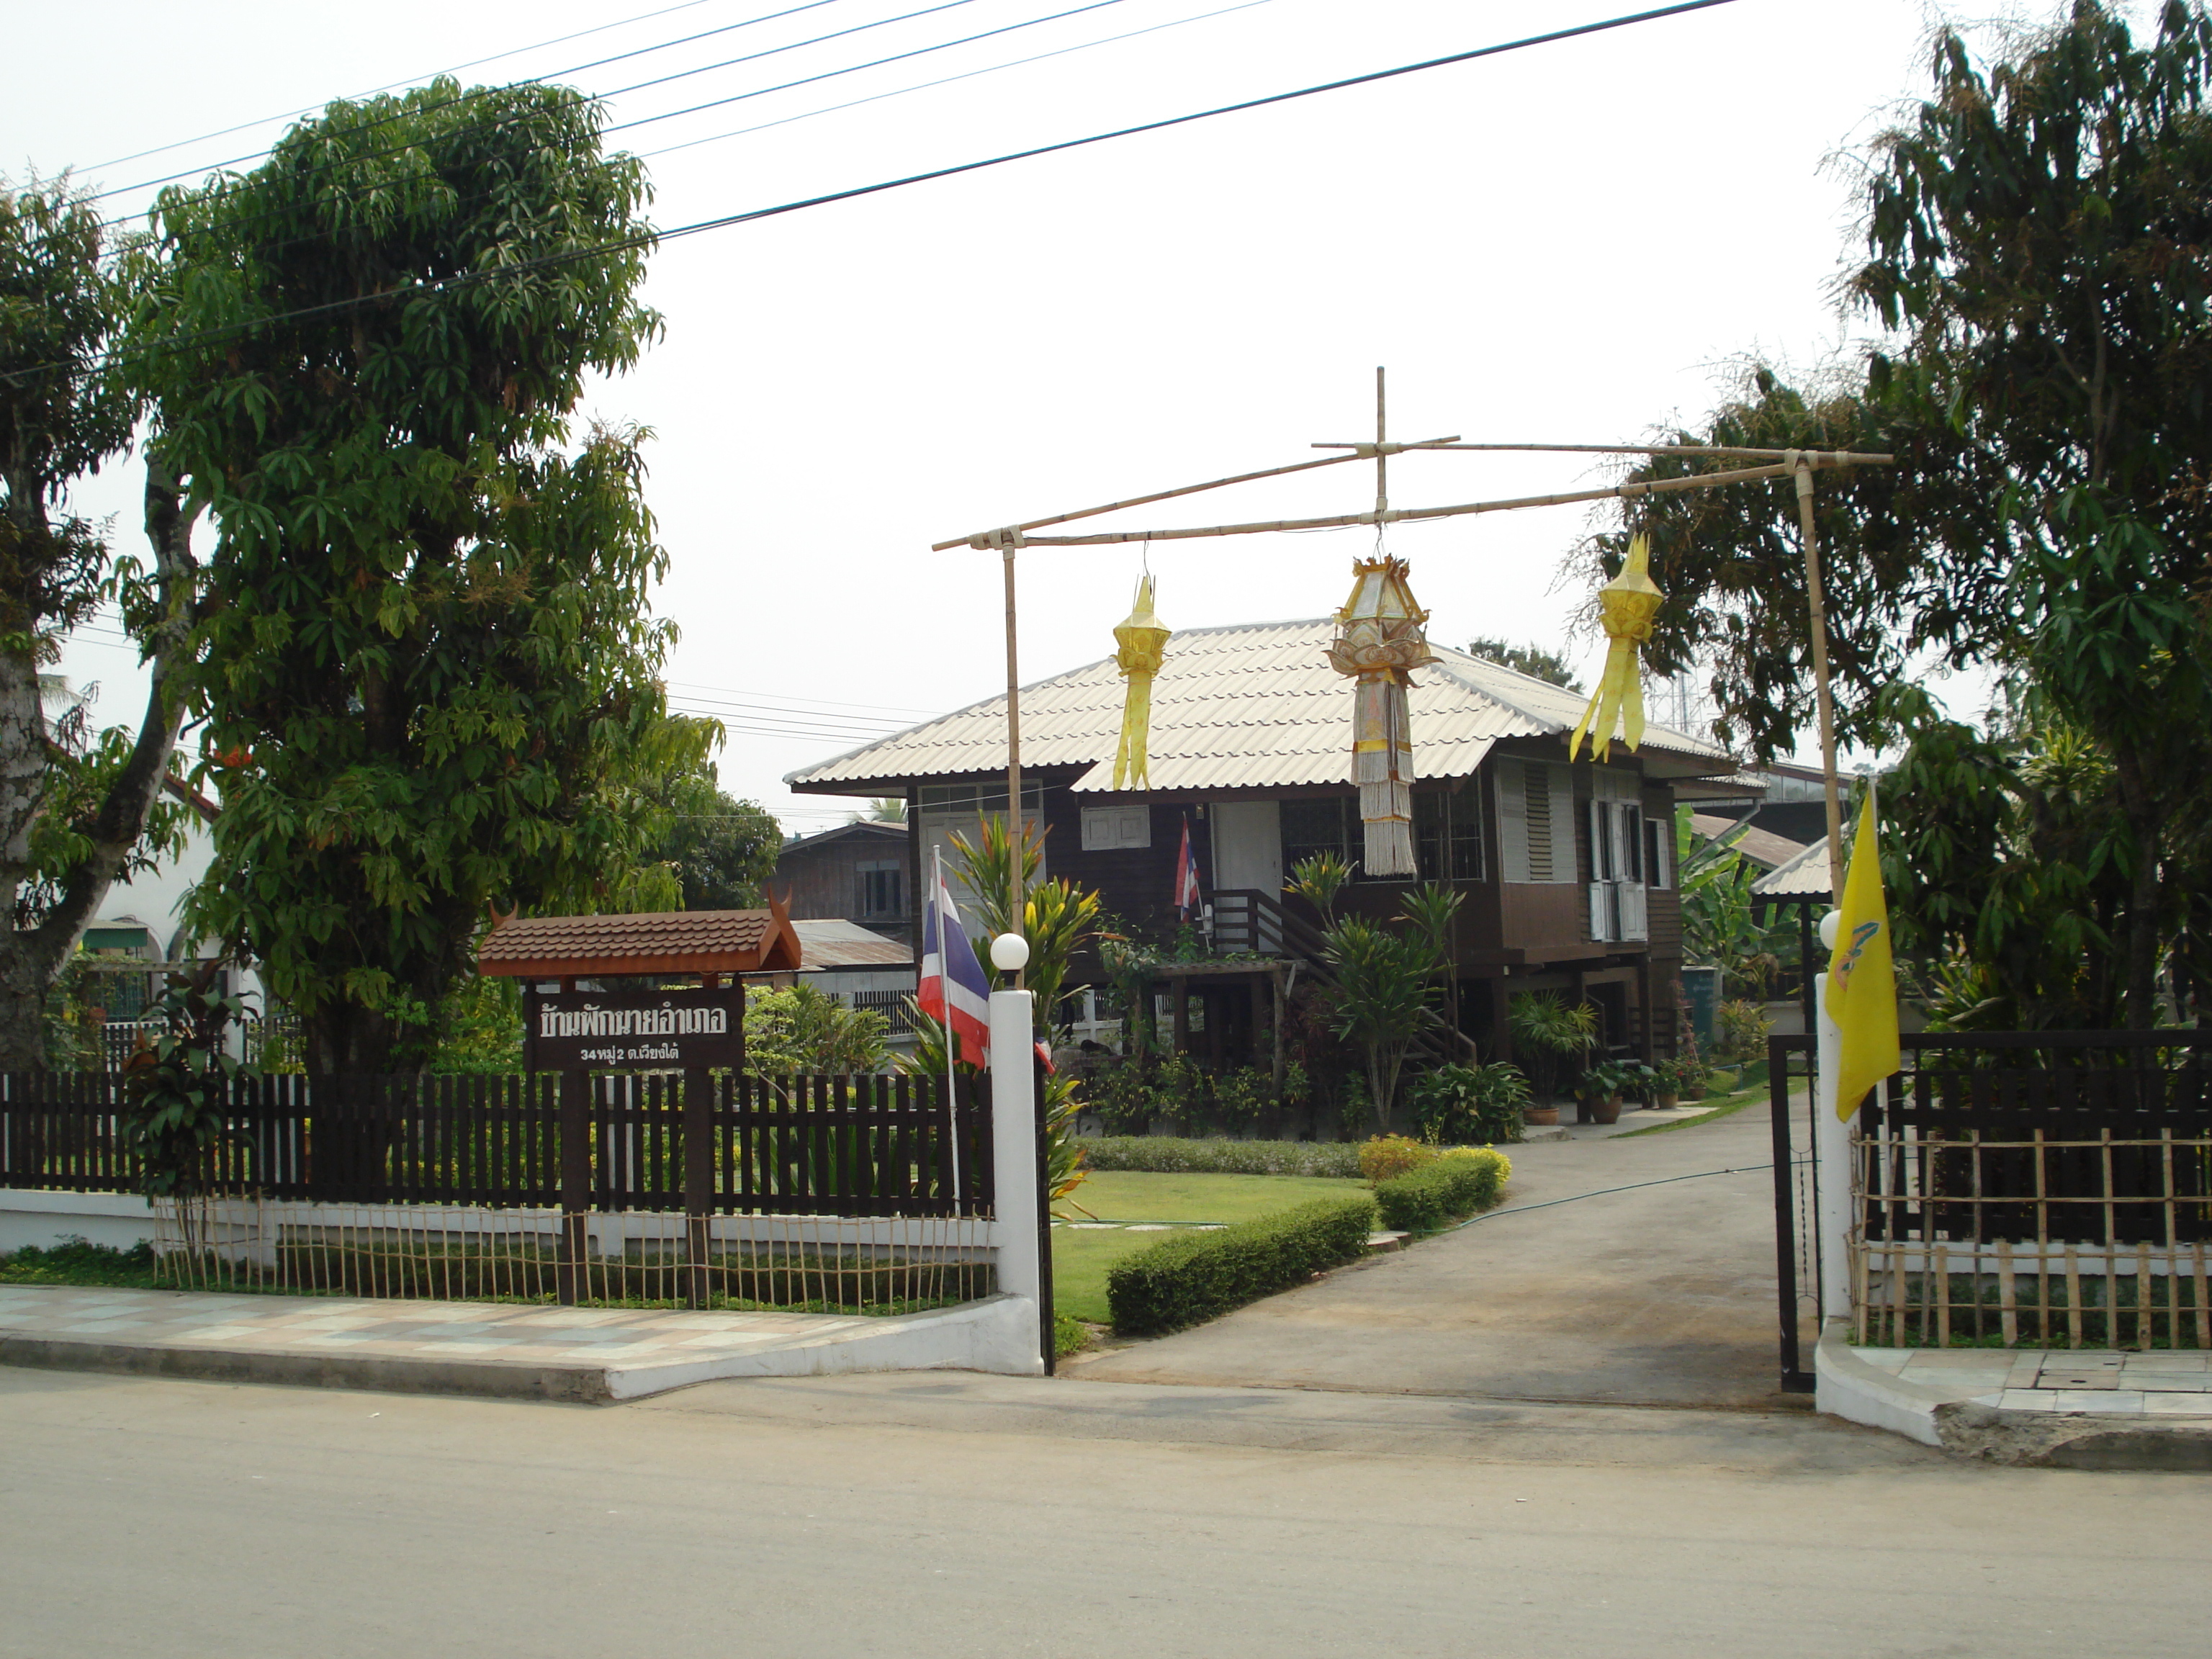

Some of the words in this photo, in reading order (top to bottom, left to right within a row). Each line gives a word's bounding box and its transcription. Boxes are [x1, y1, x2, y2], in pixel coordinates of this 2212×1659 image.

[540, 1001, 727, 1038] บ้านพักนายอำเภอ
